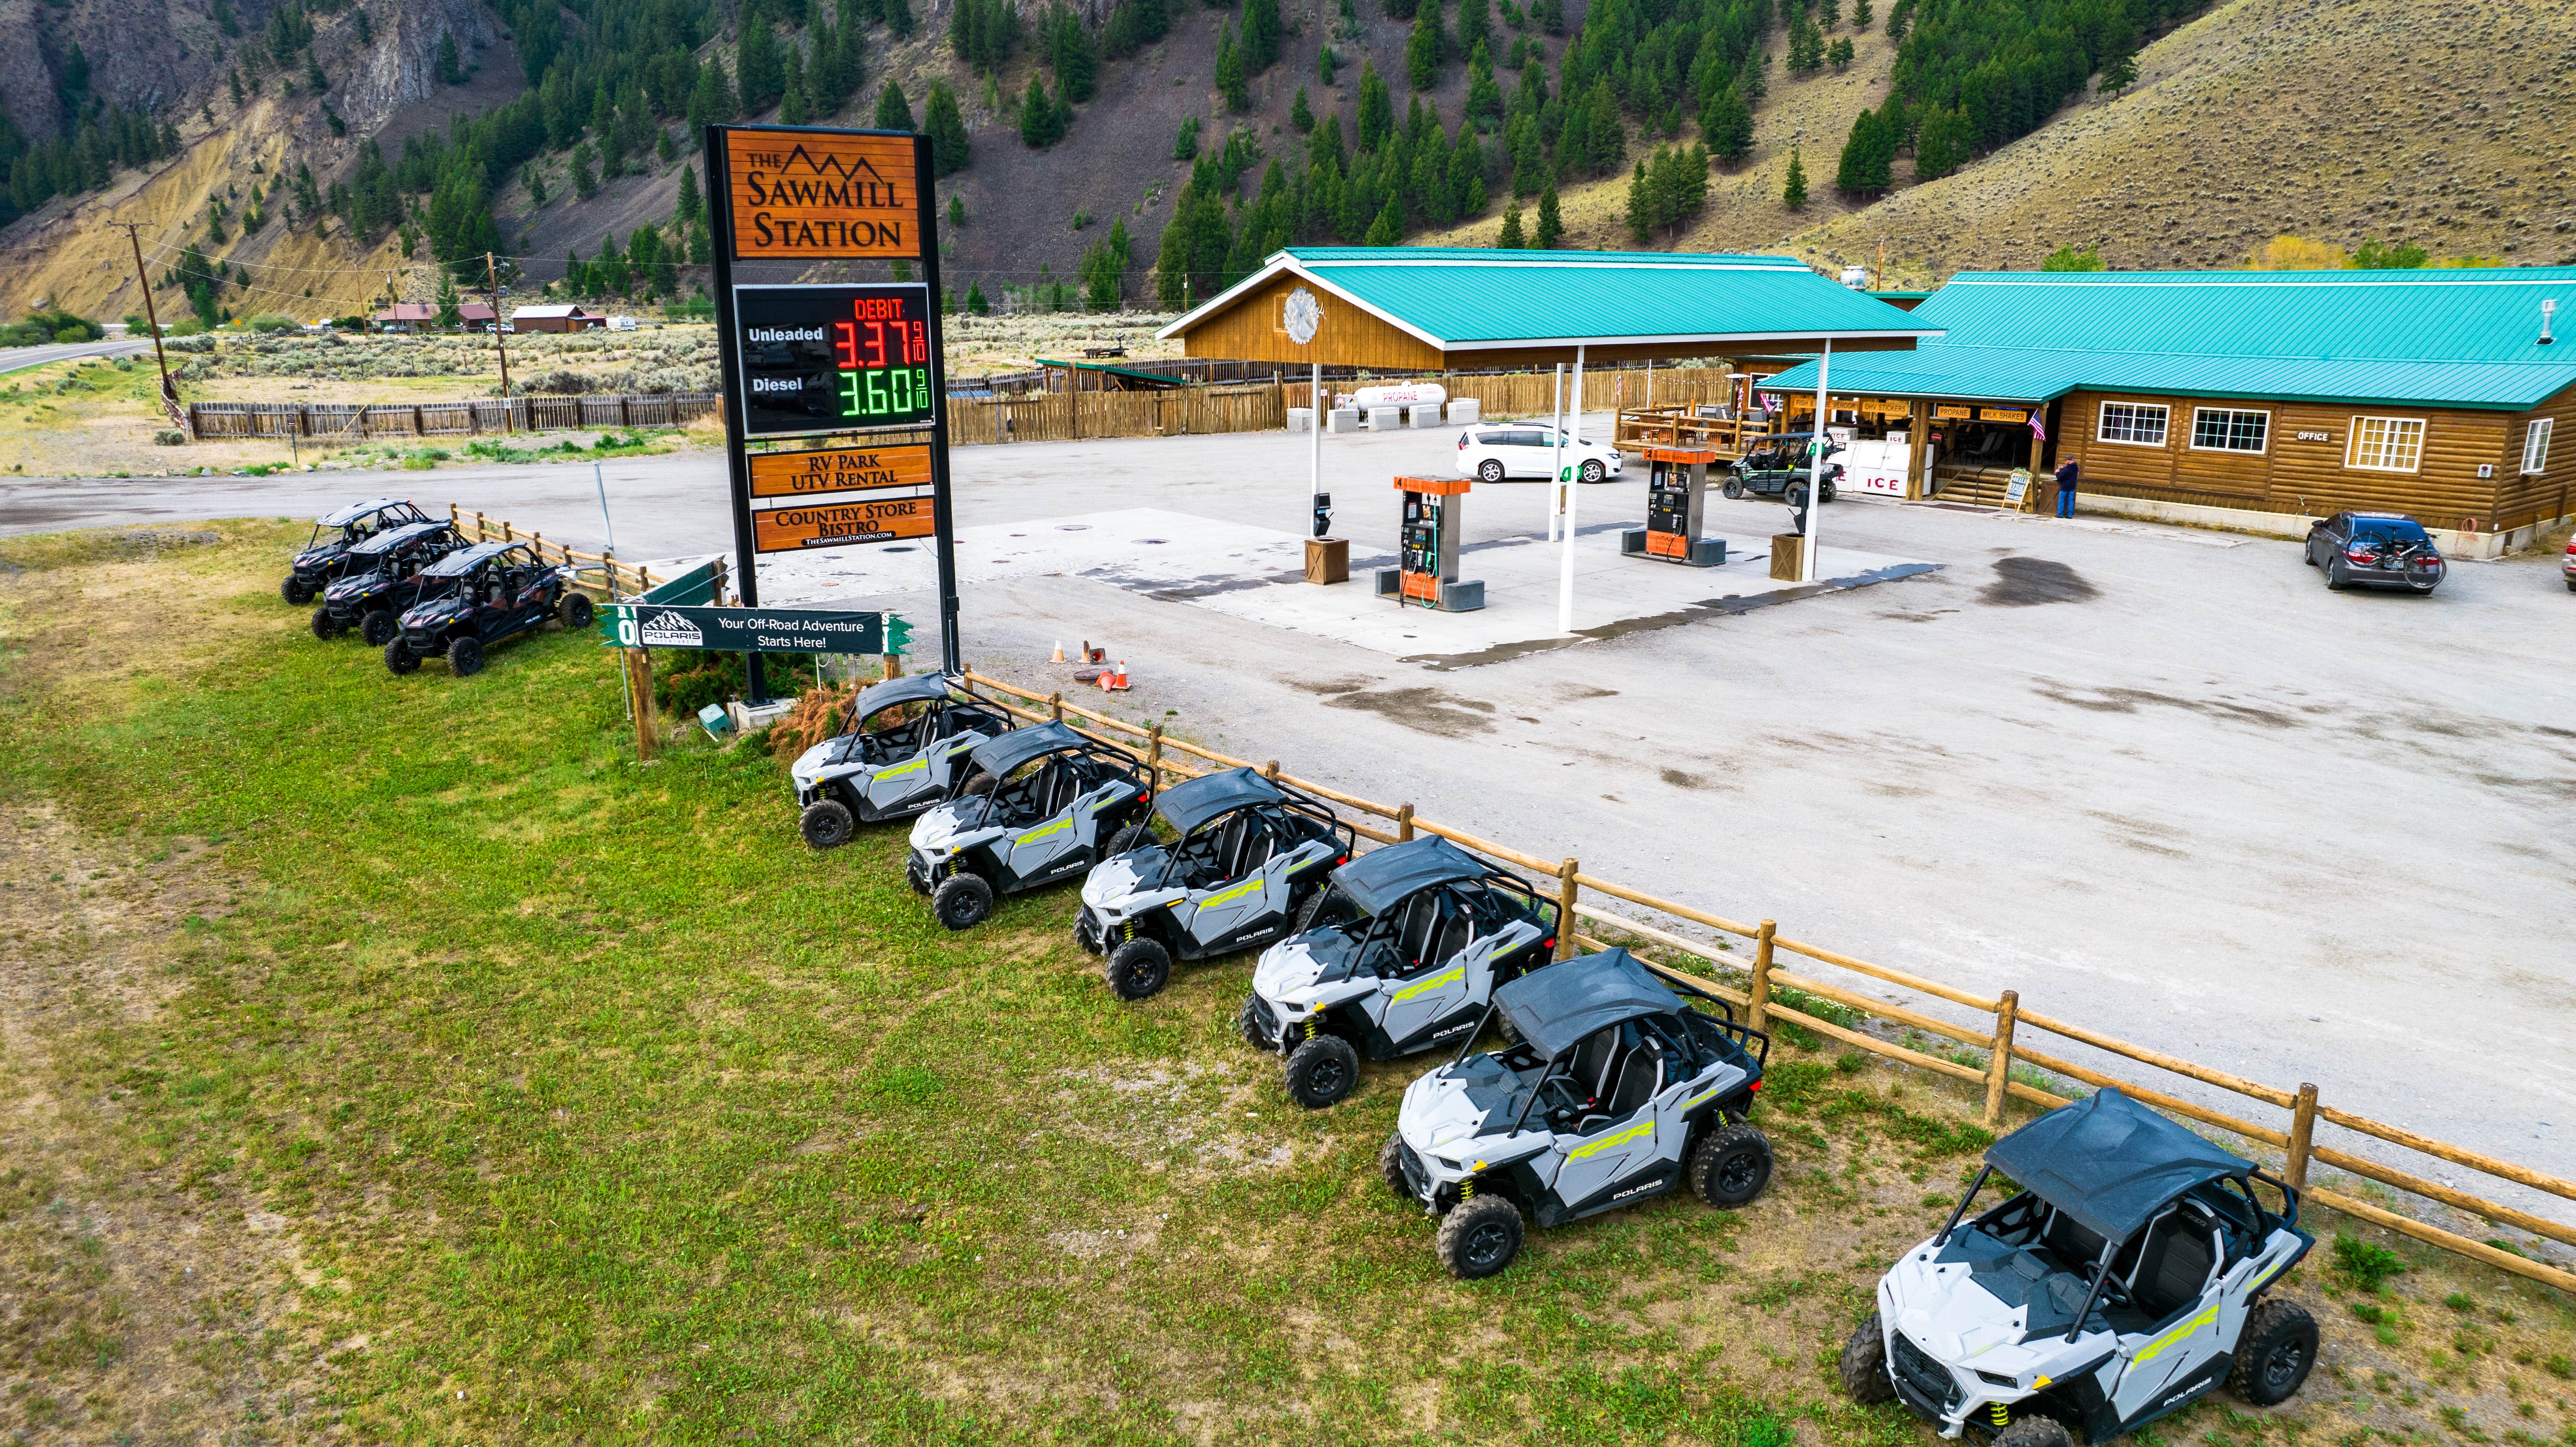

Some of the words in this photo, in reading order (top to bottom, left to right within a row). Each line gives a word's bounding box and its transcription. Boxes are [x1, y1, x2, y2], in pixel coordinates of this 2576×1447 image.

[747, 153, 782, 168] THE
[748, 171, 904, 207] SAWMILL
[754, 212, 901, 247] STATION
[855, 299, 903, 320] DEBIT
[749, 327, 823, 342] Unleaded
[834, 321, 910, 369] 3.37
[753, 378, 802, 392] Diesel
[839, 369, 912, 416] 3.60
[1383, 391, 1418, 402] PROPANE
[1940, 408, 1968, 417] PROPANE
[1999, 412, 2024, 420] SHAKES
[2298, 432, 2328, 441] OFFICE
[1810, 445, 1815, 453] 2
[808, 456, 834, 472] RV
[836, 454, 881, 470] PARK
[791, 474, 830, 491] UTV
[835, 470, 898, 487] RENTAL
[1564, 469, 1569, 478] 4
[1397, 478, 1402, 487] 4
[1867, 477, 1899, 491] ICE
[775, 507, 861, 527] COUNTRY
[866, 502, 917, 518] STORE
[818, 520, 879, 537] BISTRO
[525, 614, 541, 625] POLARIS
[718, 617, 744, 629] Your
[747, 618, 799, 631] Off-Road
[802, 620, 864, 632] Adventure
[758, 635, 791, 647] Starts
[794, 636, 826, 648] Here!
[908, 798, 940, 809] POLARIS
[1050, 860, 1085, 875] POLARIS
[1236, 927, 1273, 943] POLARIS
[1433, 1021, 1475, 1039] POLARIS
[1613, 1179, 1663, 1200] POLARIS
[2163, 1377, 2212, 1407] POLARIS
